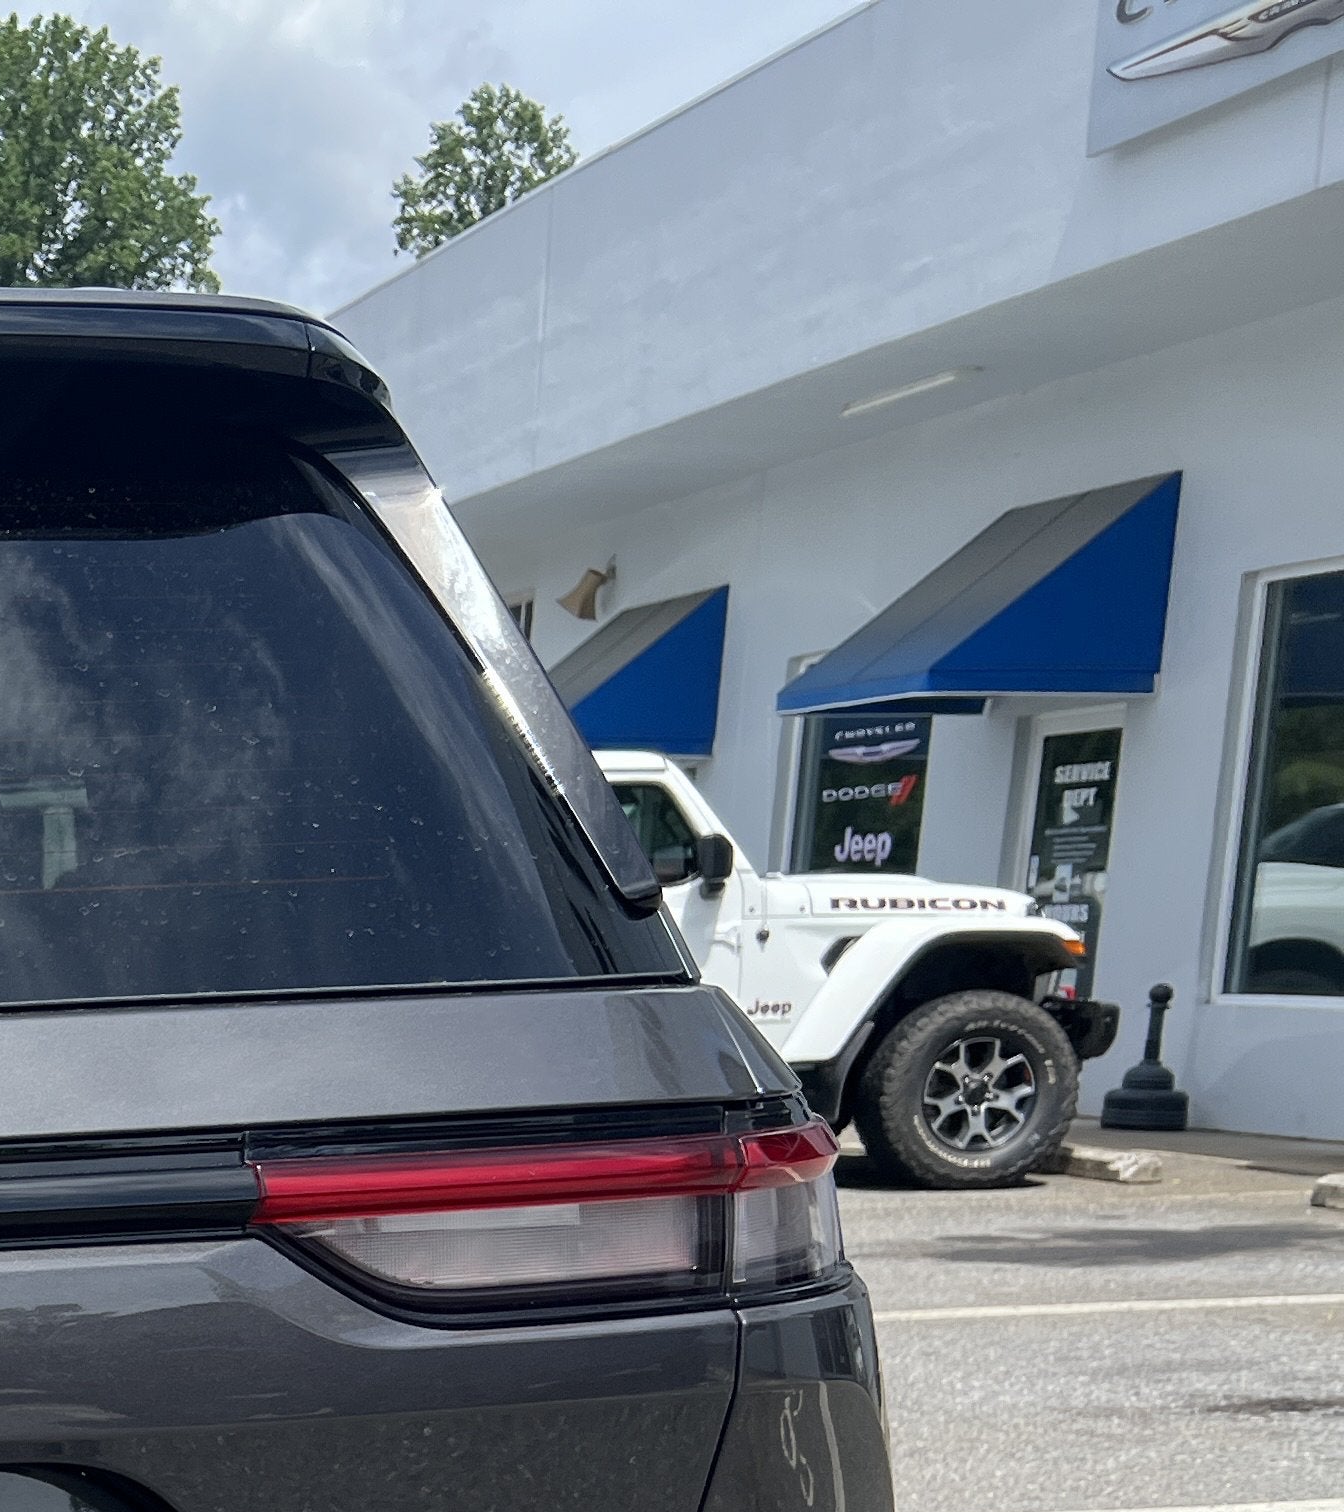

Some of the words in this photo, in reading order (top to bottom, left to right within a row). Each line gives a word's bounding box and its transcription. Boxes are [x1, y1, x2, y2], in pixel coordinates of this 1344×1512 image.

[1054, 761, 1111, 783] SERVICE
[822, 782, 903, 803] DODGE
[834, 826, 892, 867] Jeep
[830, 897, 1007, 911] RUBICON
[747, 998, 792, 1016] Jeep
